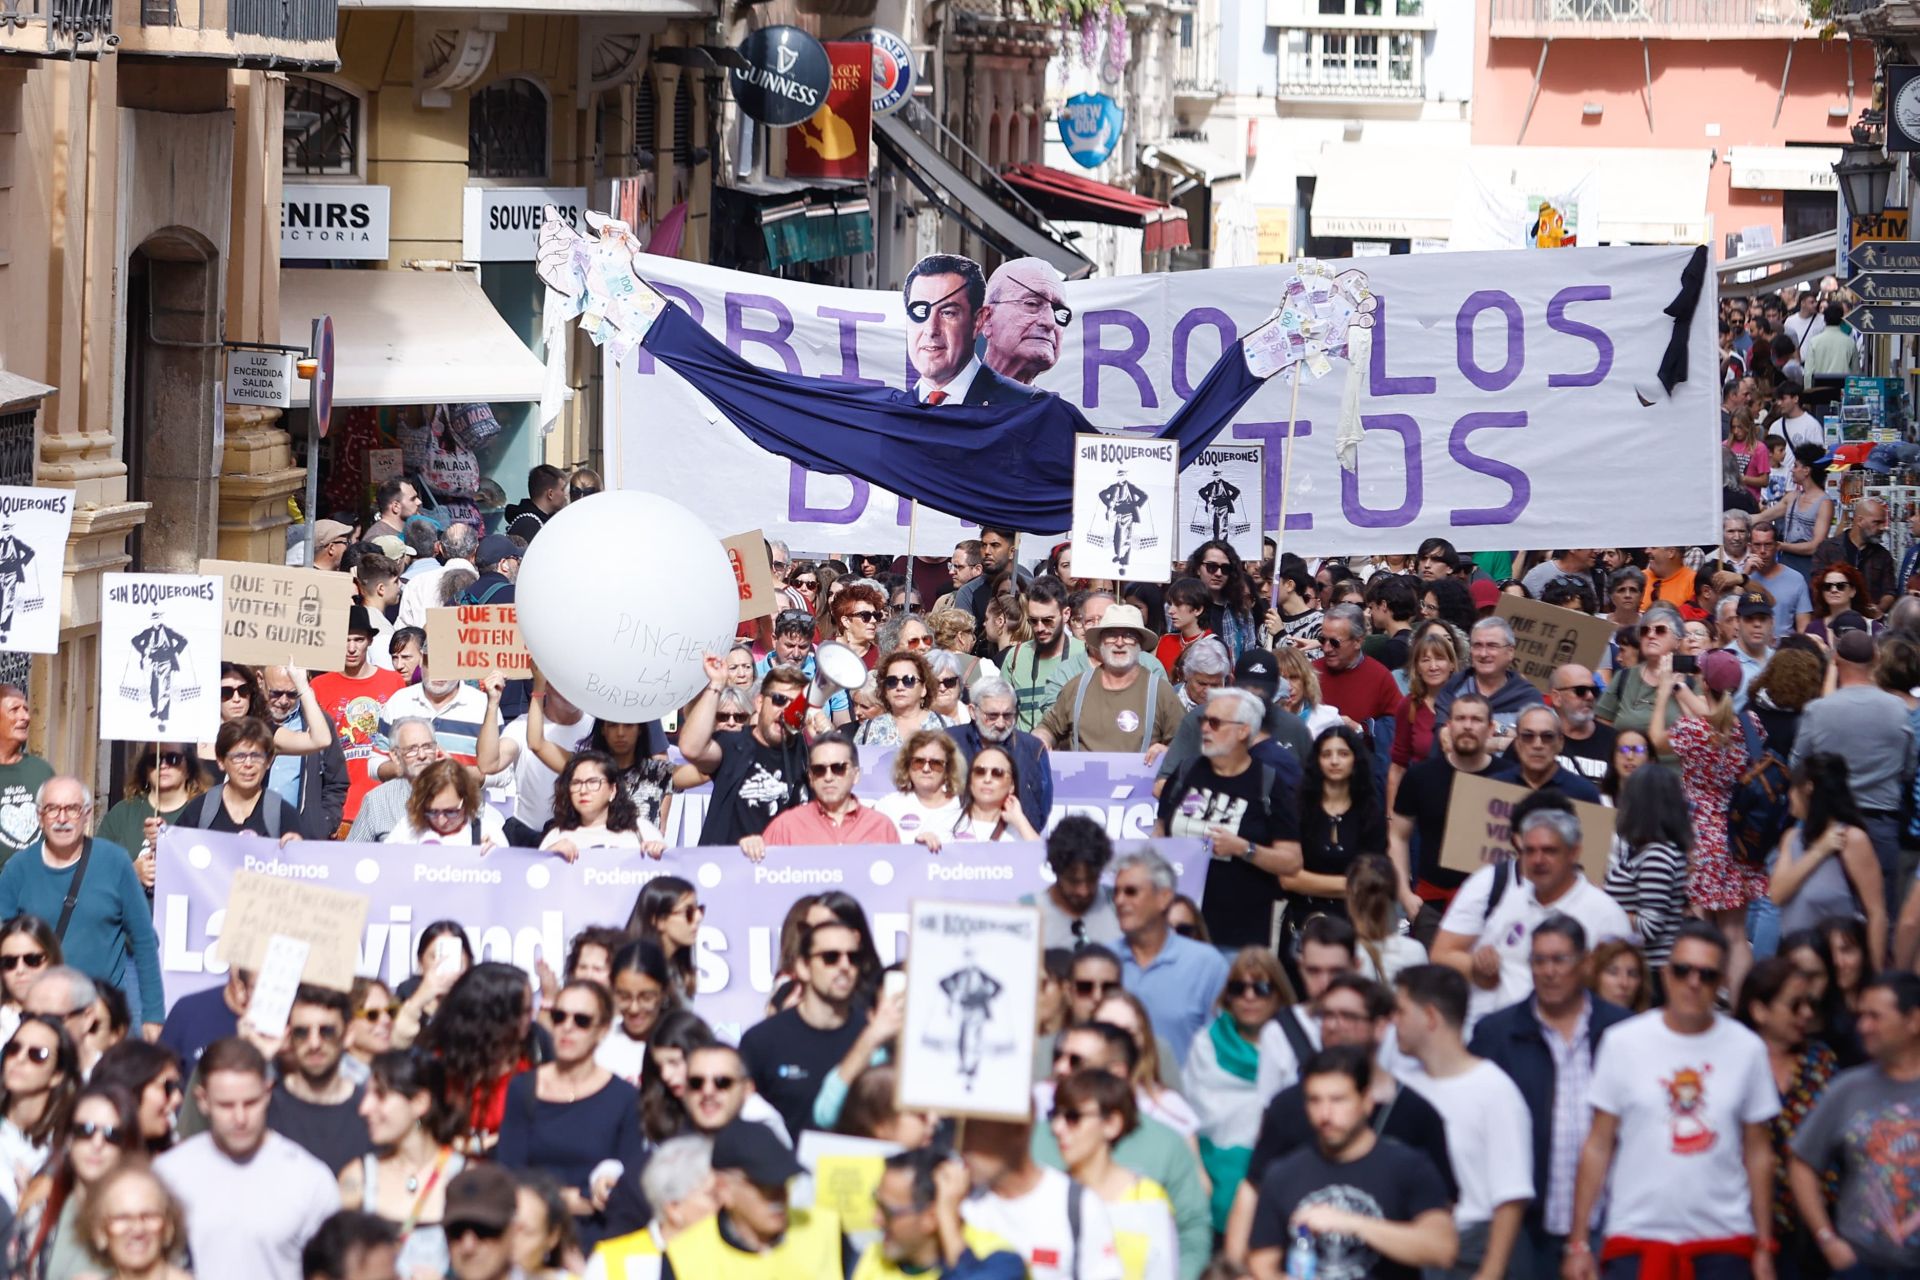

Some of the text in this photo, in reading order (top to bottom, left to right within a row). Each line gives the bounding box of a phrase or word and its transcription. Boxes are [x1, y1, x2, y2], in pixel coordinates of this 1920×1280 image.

[735, 62, 818, 106] GUINNESS
[281, 230, 370, 241] ICTORIA
[1884, 256, 1920, 267] LA CON
[619, 275, 634, 293] 100
[1281, 311, 1294, 328] 100
[1263, 326, 1280, 344] 500
[1369, 284, 1615, 396] LOS
[1270, 340, 1288, 355] 500
[251, 357, 268, 366] LUZ
[234, 366, 284, 378] ENCENDIDA
[242, 378, 274, 388] SALIDA
[233, 387, 282, 400] VEHÍCULOS
[1081, 446, 1098, 461] SIN
[1101, 444, 1173, 464] BOQUERONES
[1198, 449, 1259, 466] BOQUERONES
[0, 496, 67, 518] QUERONES
[109, 582, 214, 605] SIN BOQUERONES
[230, 574, 294, 597] QUE TE
[228, 597, 288, 618] VOTEN
[457, 606, 517, 624] QUE TE
[224, 620, 327, 648] LOS GUIRIS
[457, 628, 514, 646] VOTEN
[1541, 622, 1560, 639] TE
[457, 650, 490, 668] LOS
[638, 666, 672, 688] LA
[585, 672, 695, 707] BURBUJA
[243, 854, 329, 879] Podemos
[414, 863, 502, 884] Podemos
[754, 865, 843, 884] Podemos
[927, 863, 1014, 882] Podemos
